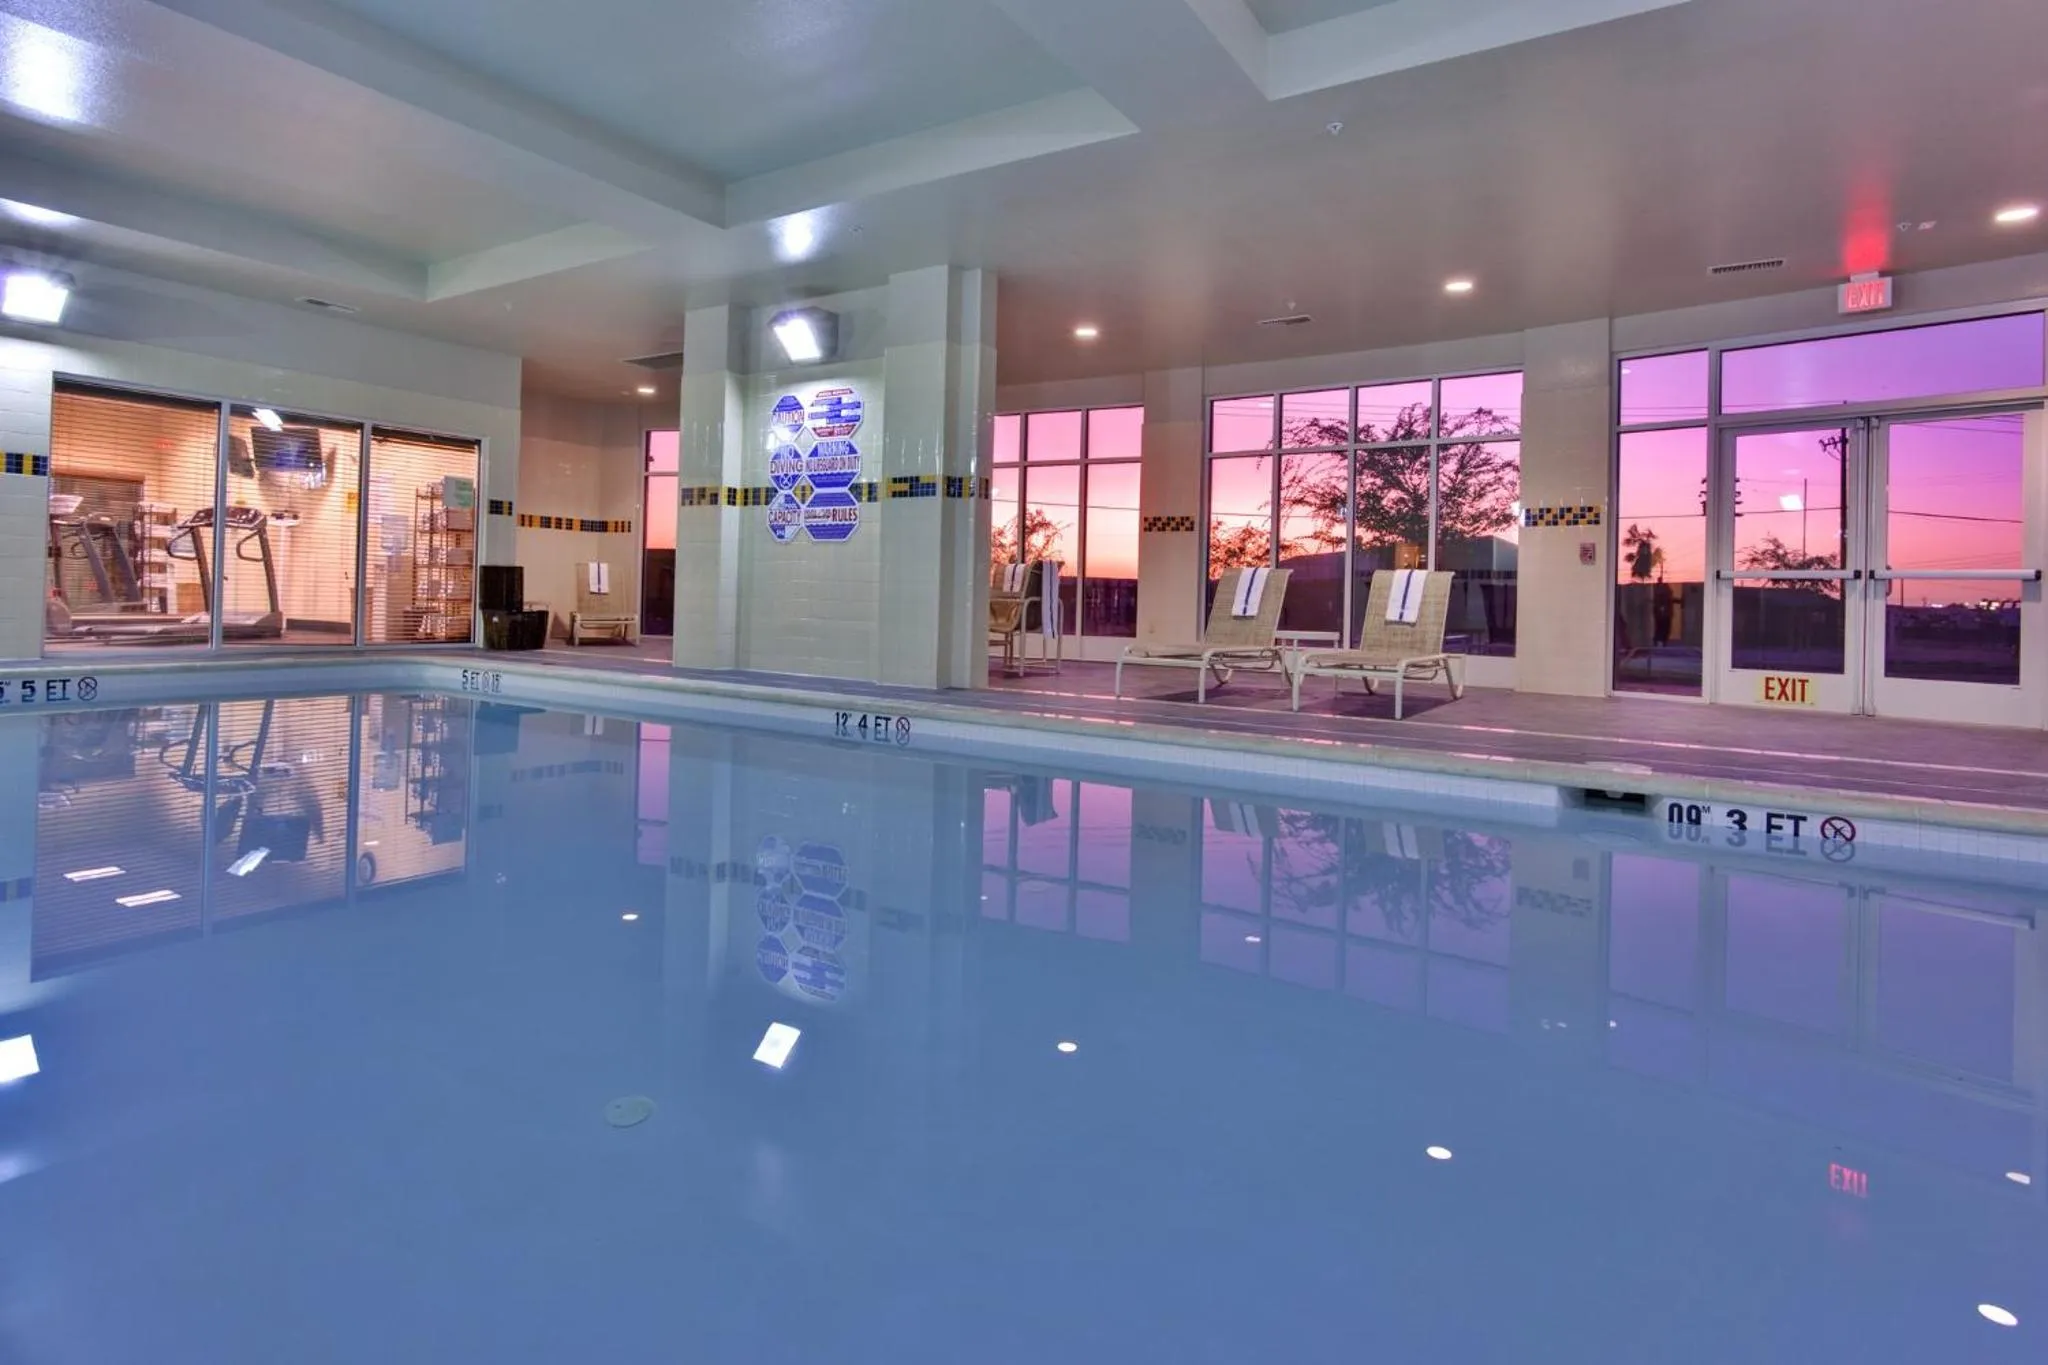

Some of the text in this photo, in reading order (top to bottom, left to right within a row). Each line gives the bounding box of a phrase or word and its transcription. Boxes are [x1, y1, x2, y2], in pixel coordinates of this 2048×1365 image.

[1847, 282, 1885, 309] EXIT
[771, 410, 804, 425] CAUTION
[770, 460, 803, 474] DIVING
[769, 510, 801, 524] CAPACITY
[832, 508, 858, 522] RULES
[1765, 677, 1809, 702] EXIT
[858, 714, 868, 729] 4
[1726, 809, 1748, 831] 3
[1766, 812, 1809, 837] FT
